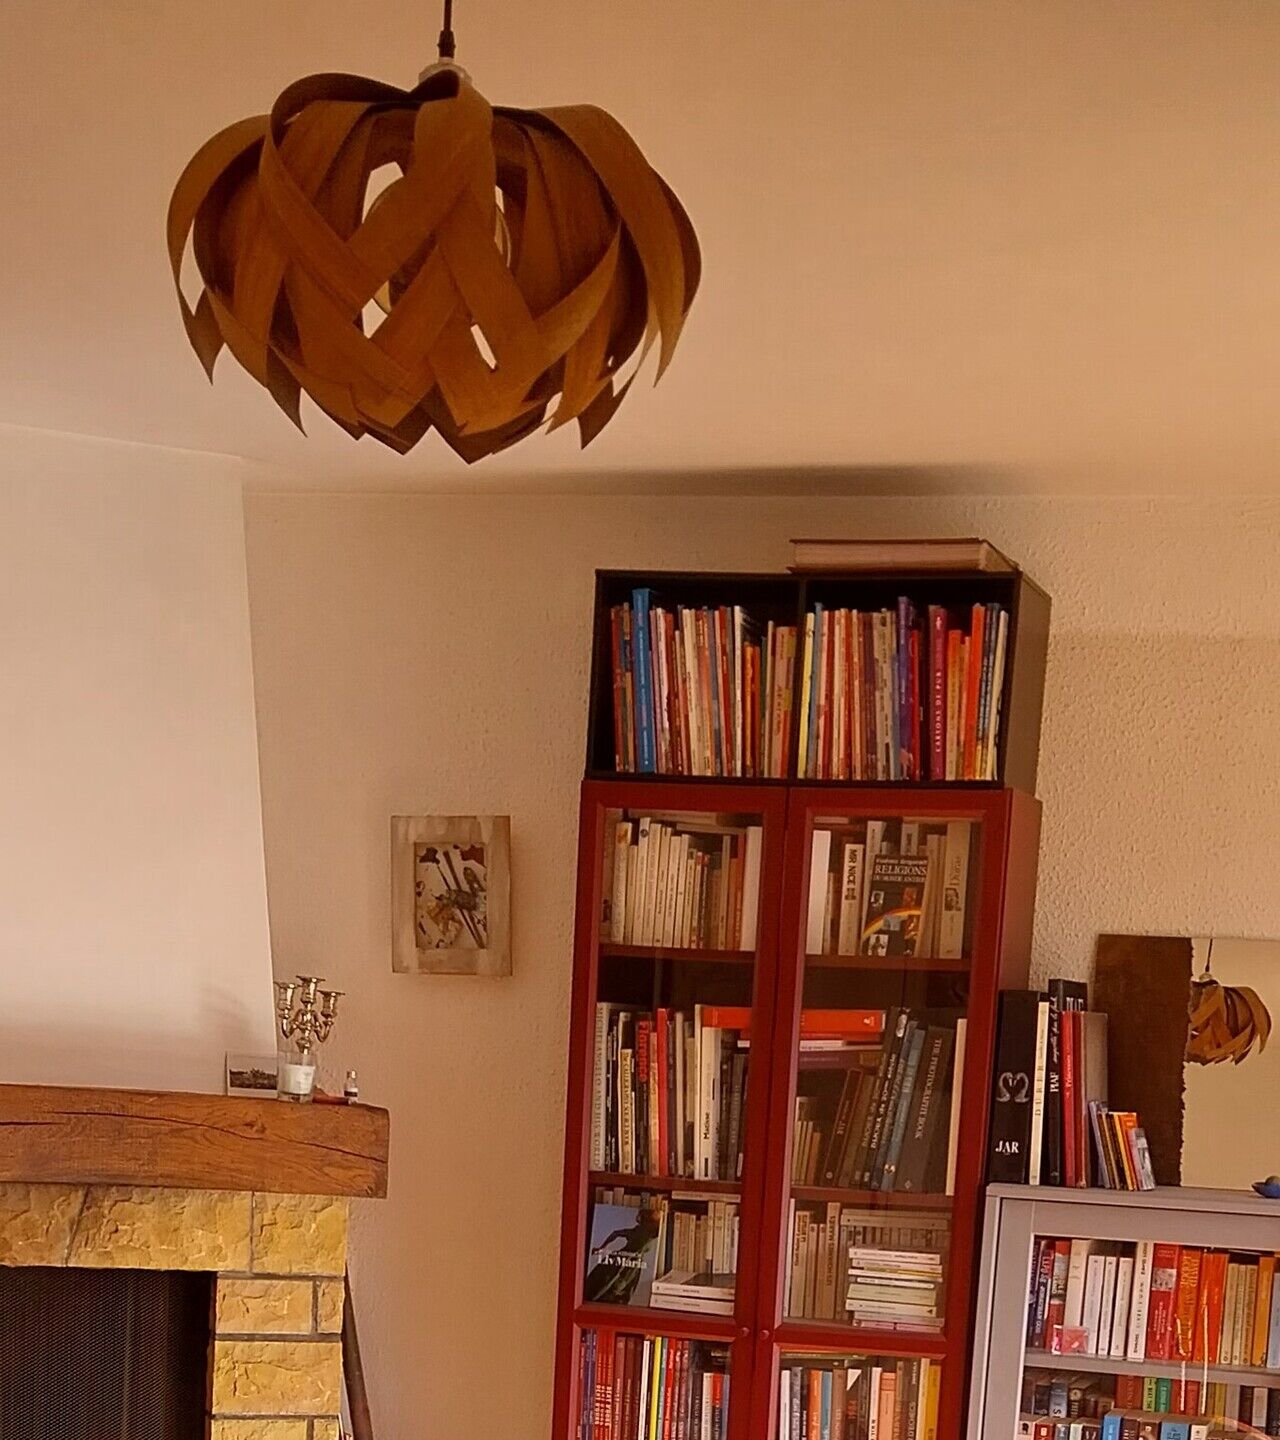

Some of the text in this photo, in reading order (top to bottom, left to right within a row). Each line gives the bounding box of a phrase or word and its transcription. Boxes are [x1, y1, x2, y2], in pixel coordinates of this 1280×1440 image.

[847, 849, 858, 886] MR NICE
[875, 865, 927, 875] RELIGIONS
[638, 1021, 649, 1082] Florence
[914, 1038, 942, 1139] THE PHOTOGRAPHY BOOK
[1050, 1072, 1059, 1092] PIAF
[995, 1140, 1019, 1154] JAR
